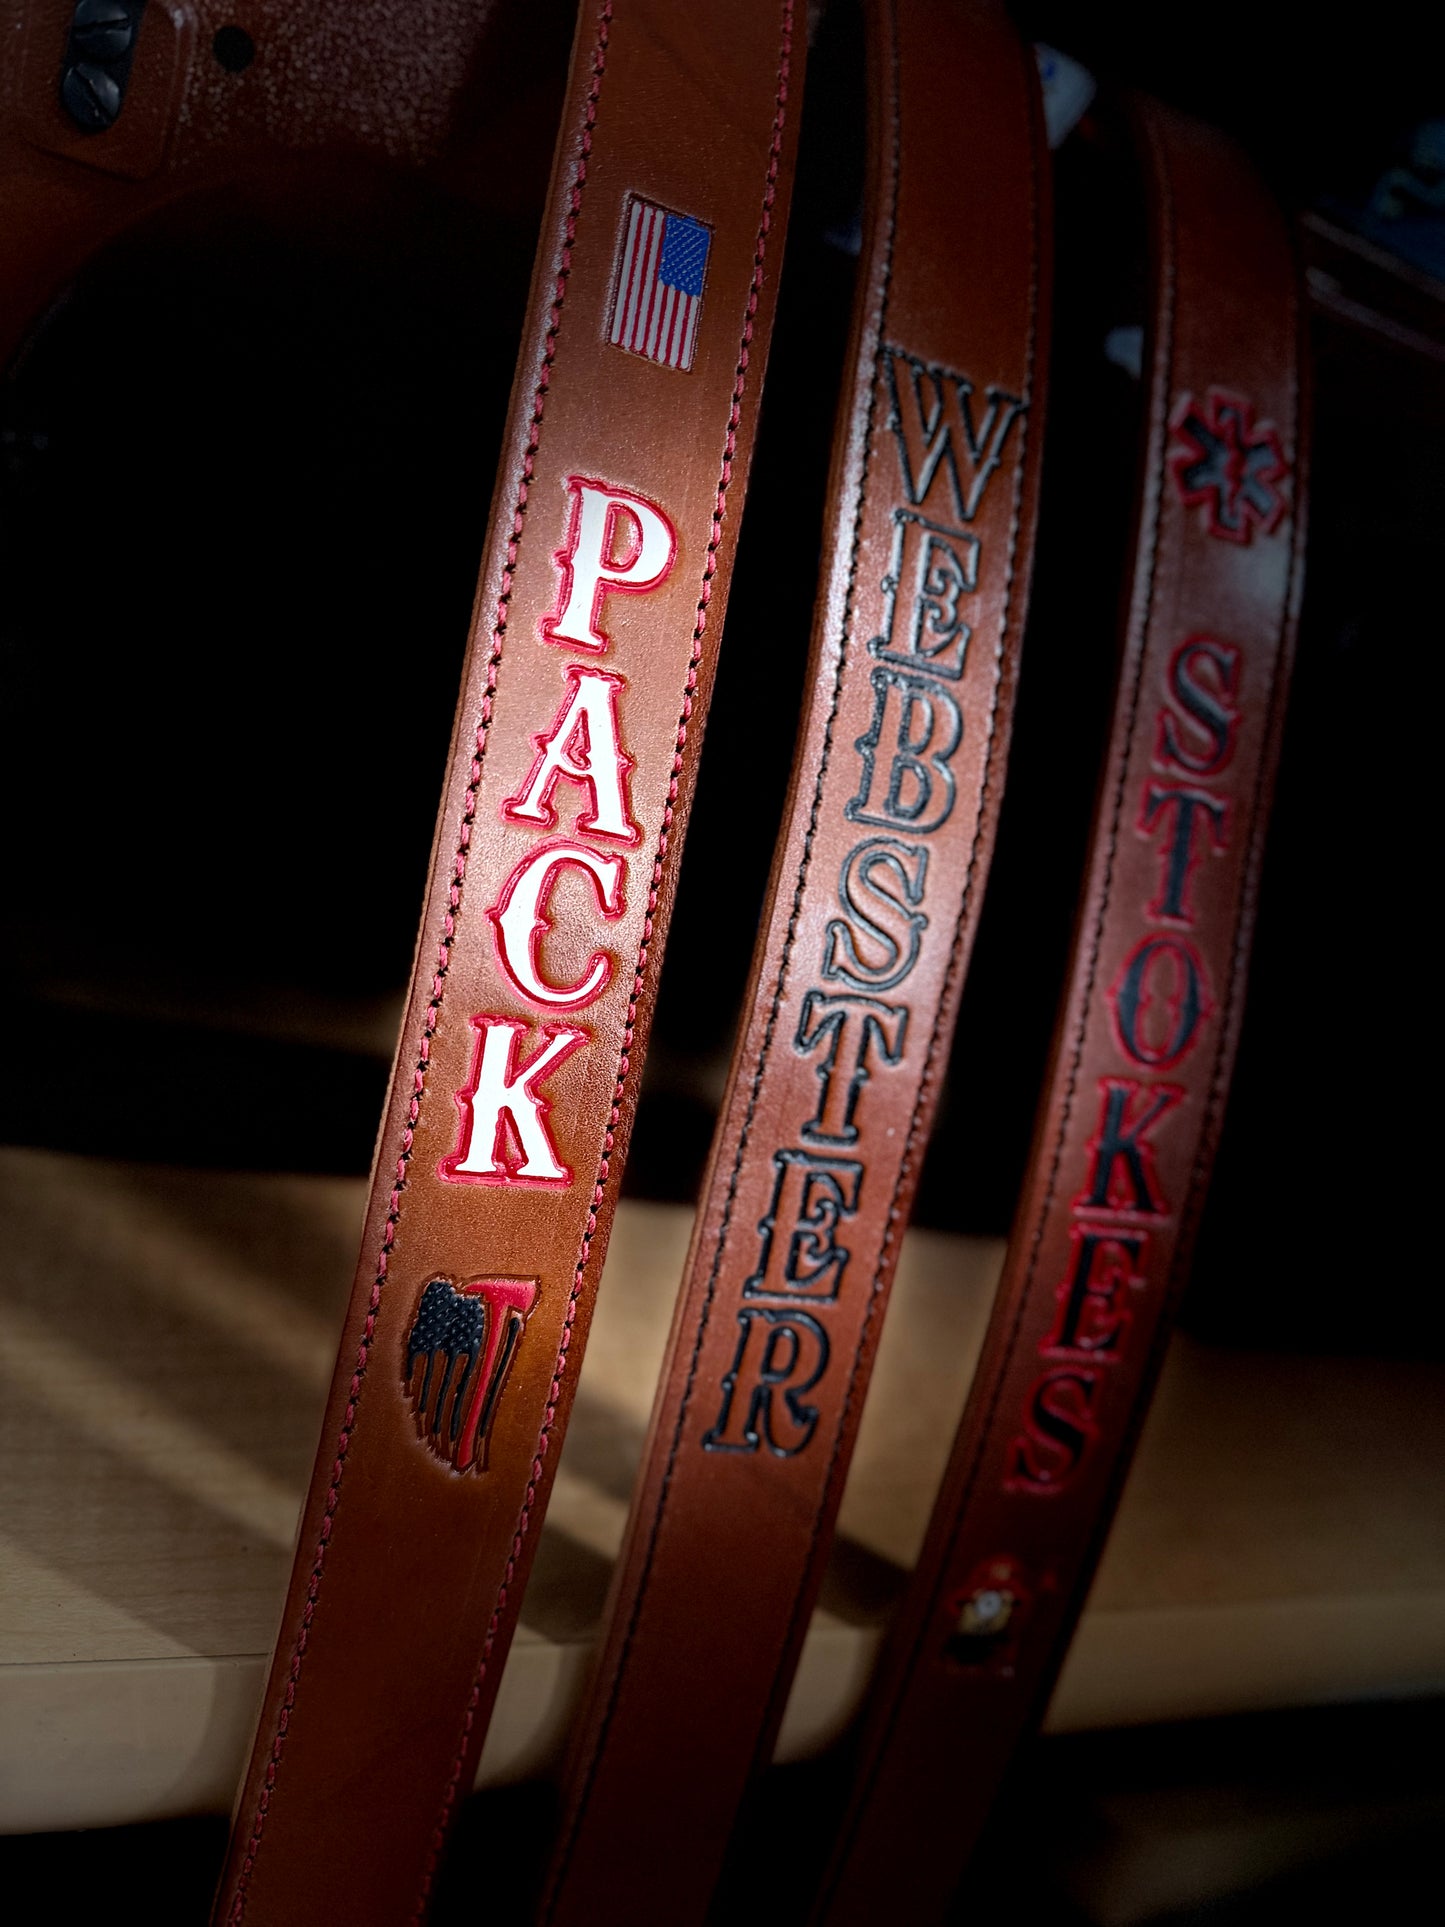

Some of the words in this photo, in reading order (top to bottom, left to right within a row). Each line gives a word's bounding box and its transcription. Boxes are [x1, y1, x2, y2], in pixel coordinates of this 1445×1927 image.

[438, 474, 677, 1187] PACK
[704, 343, 1029, 1459] WEBSTER
[1002, 635, 1243, 1495] STOKES
